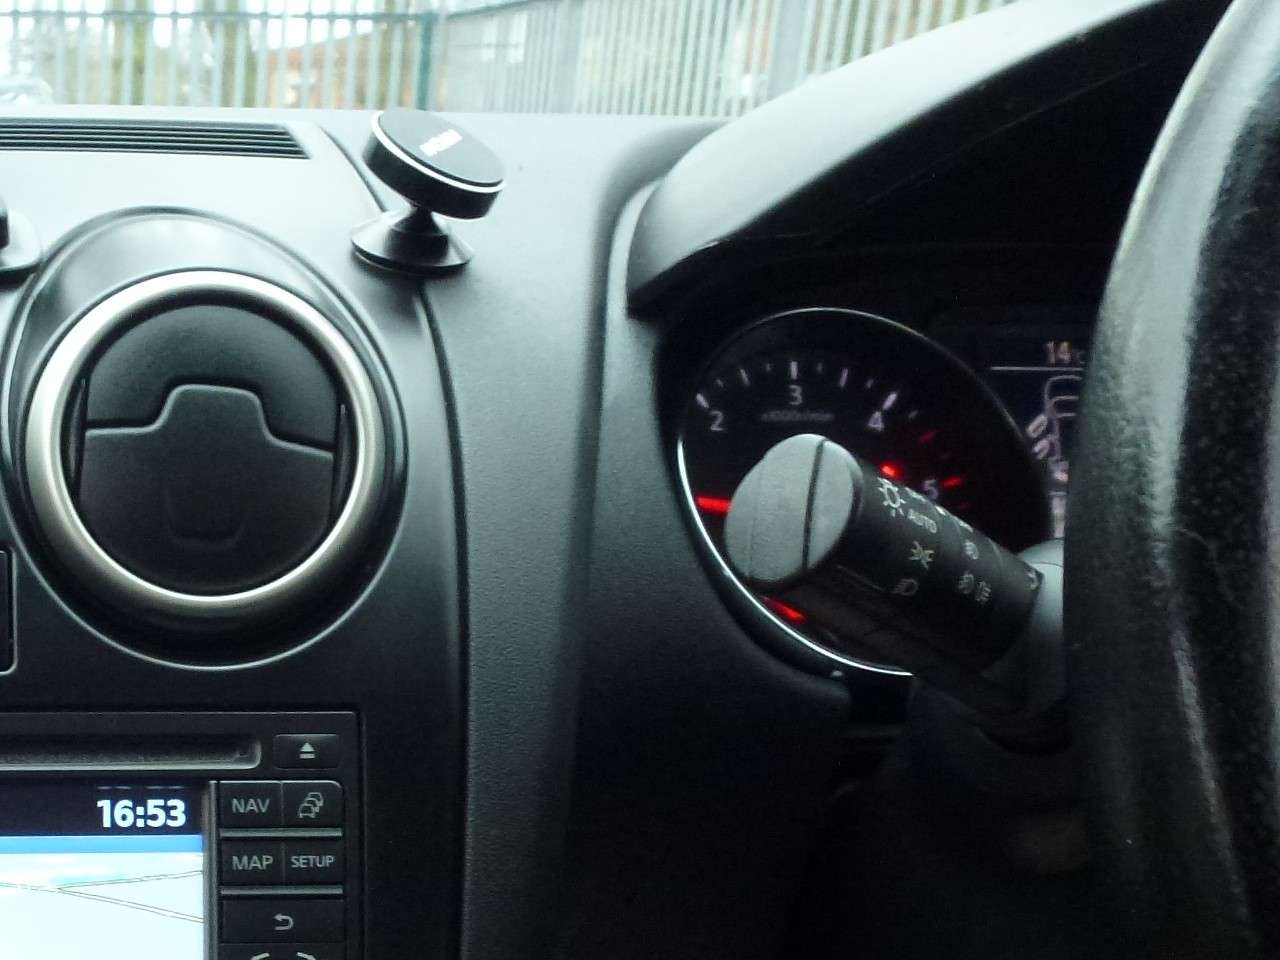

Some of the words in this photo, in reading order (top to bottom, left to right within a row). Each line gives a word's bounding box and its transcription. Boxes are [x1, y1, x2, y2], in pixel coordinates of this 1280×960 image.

[788, 385, 803, 405] 3
[709, 410, 725, 431] 2
[868, 410, 885, 432] 4
[96, 799, 187, 828] 16:53
[231, 798, 271, 814] NAV
[231, 855, 273, 871] MAP
[290, 855, 334, 869] SETUP
